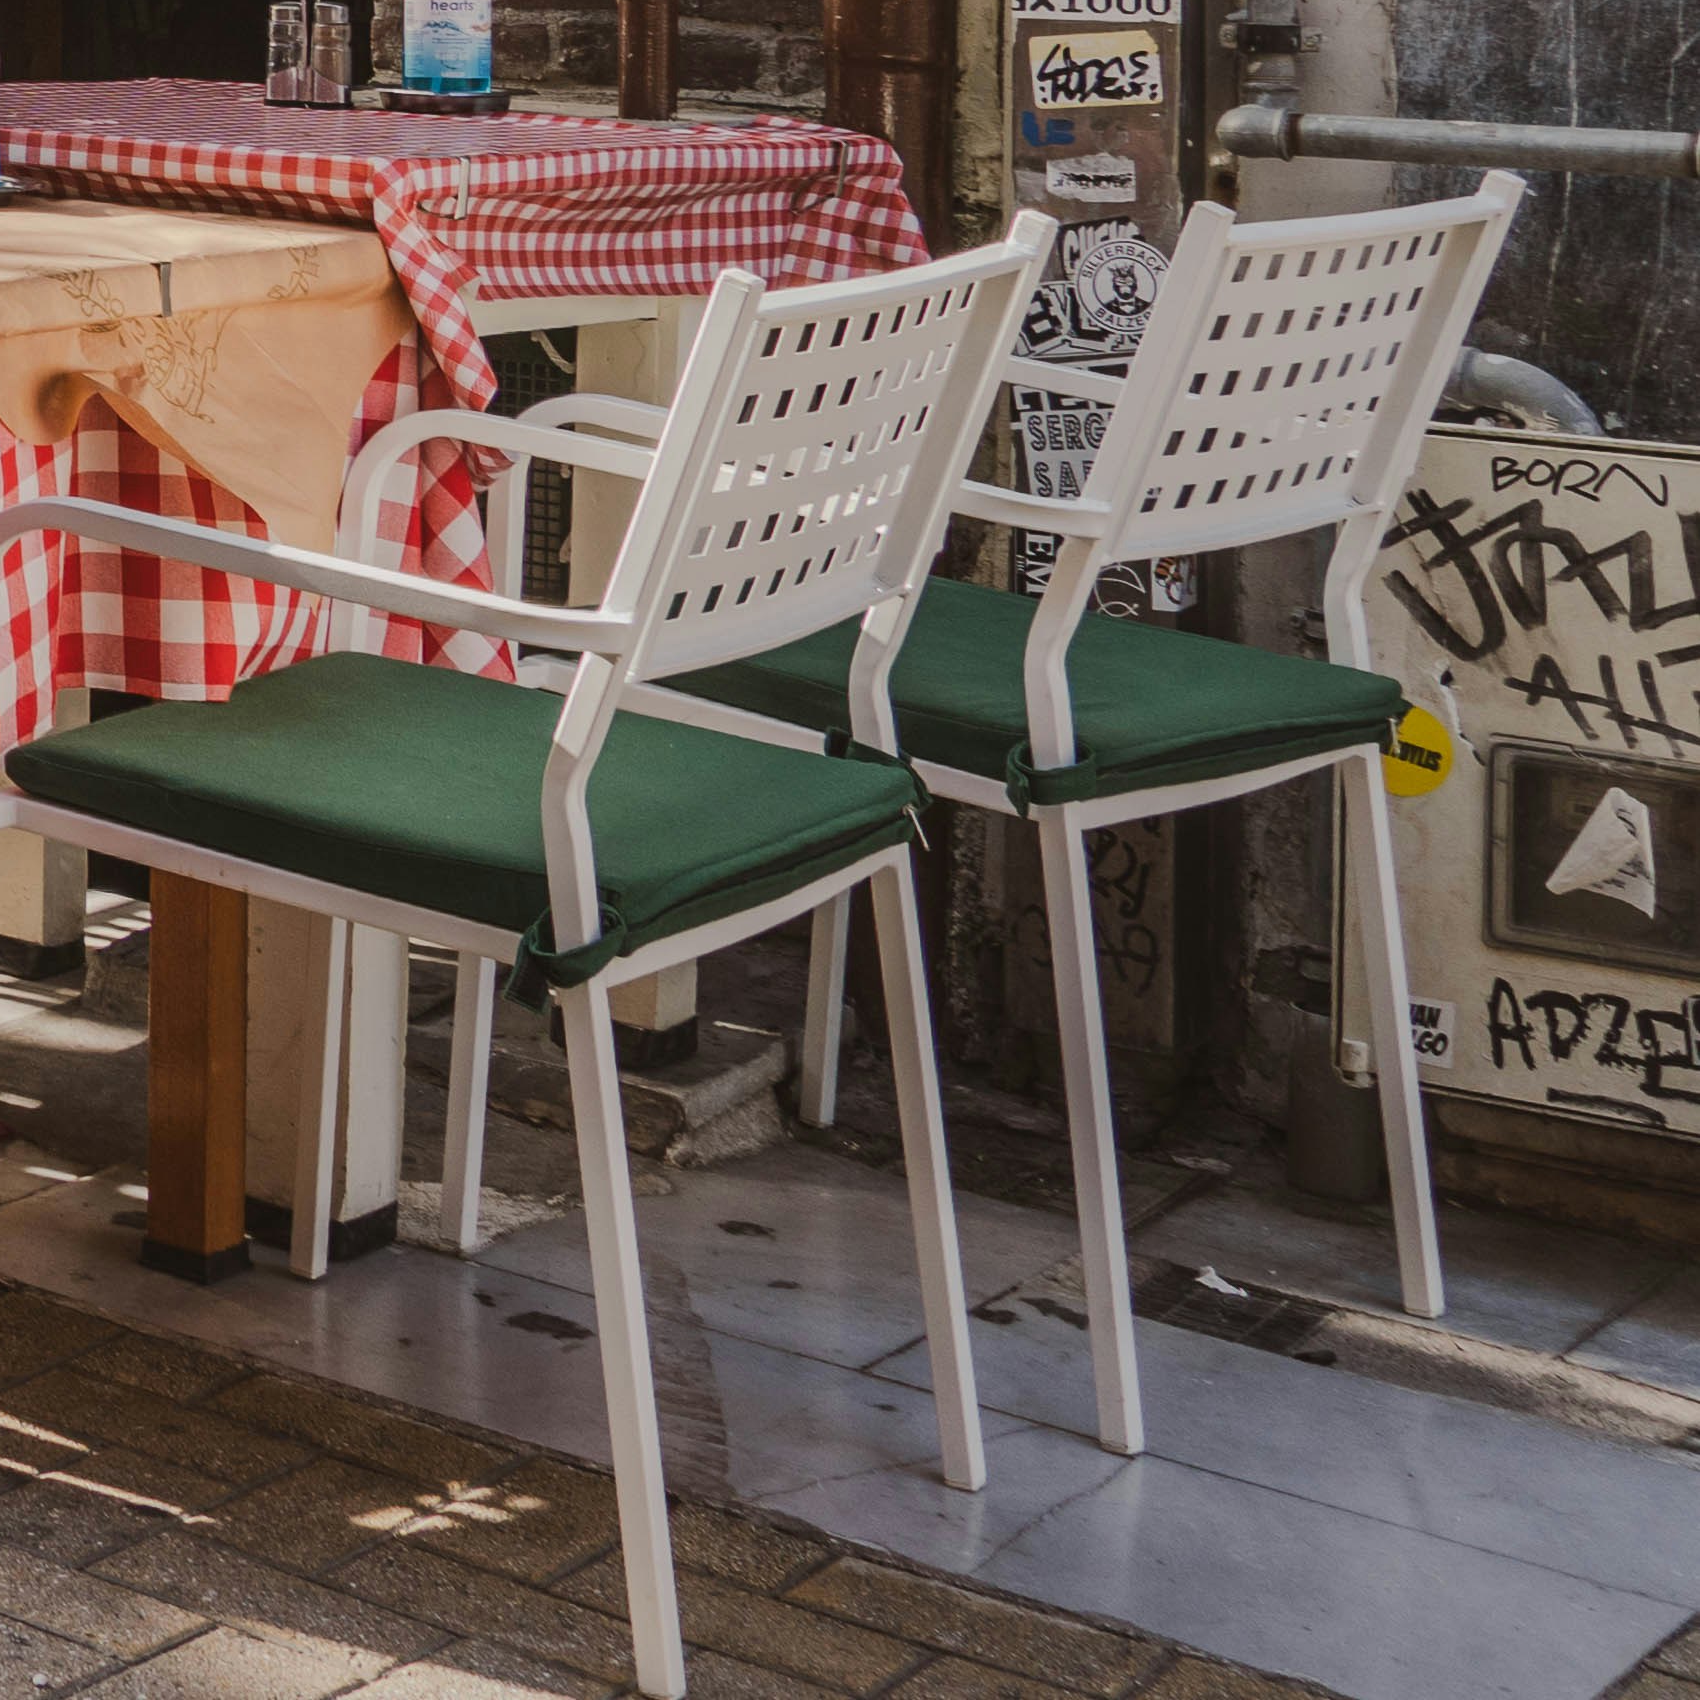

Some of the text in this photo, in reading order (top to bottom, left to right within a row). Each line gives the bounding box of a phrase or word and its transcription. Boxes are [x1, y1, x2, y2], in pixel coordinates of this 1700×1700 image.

[430, 0, 474, 11] hearts
[1082, 245, 1166, 279] SILVERBACK
[1027, 412, 1113, 452] SERG
